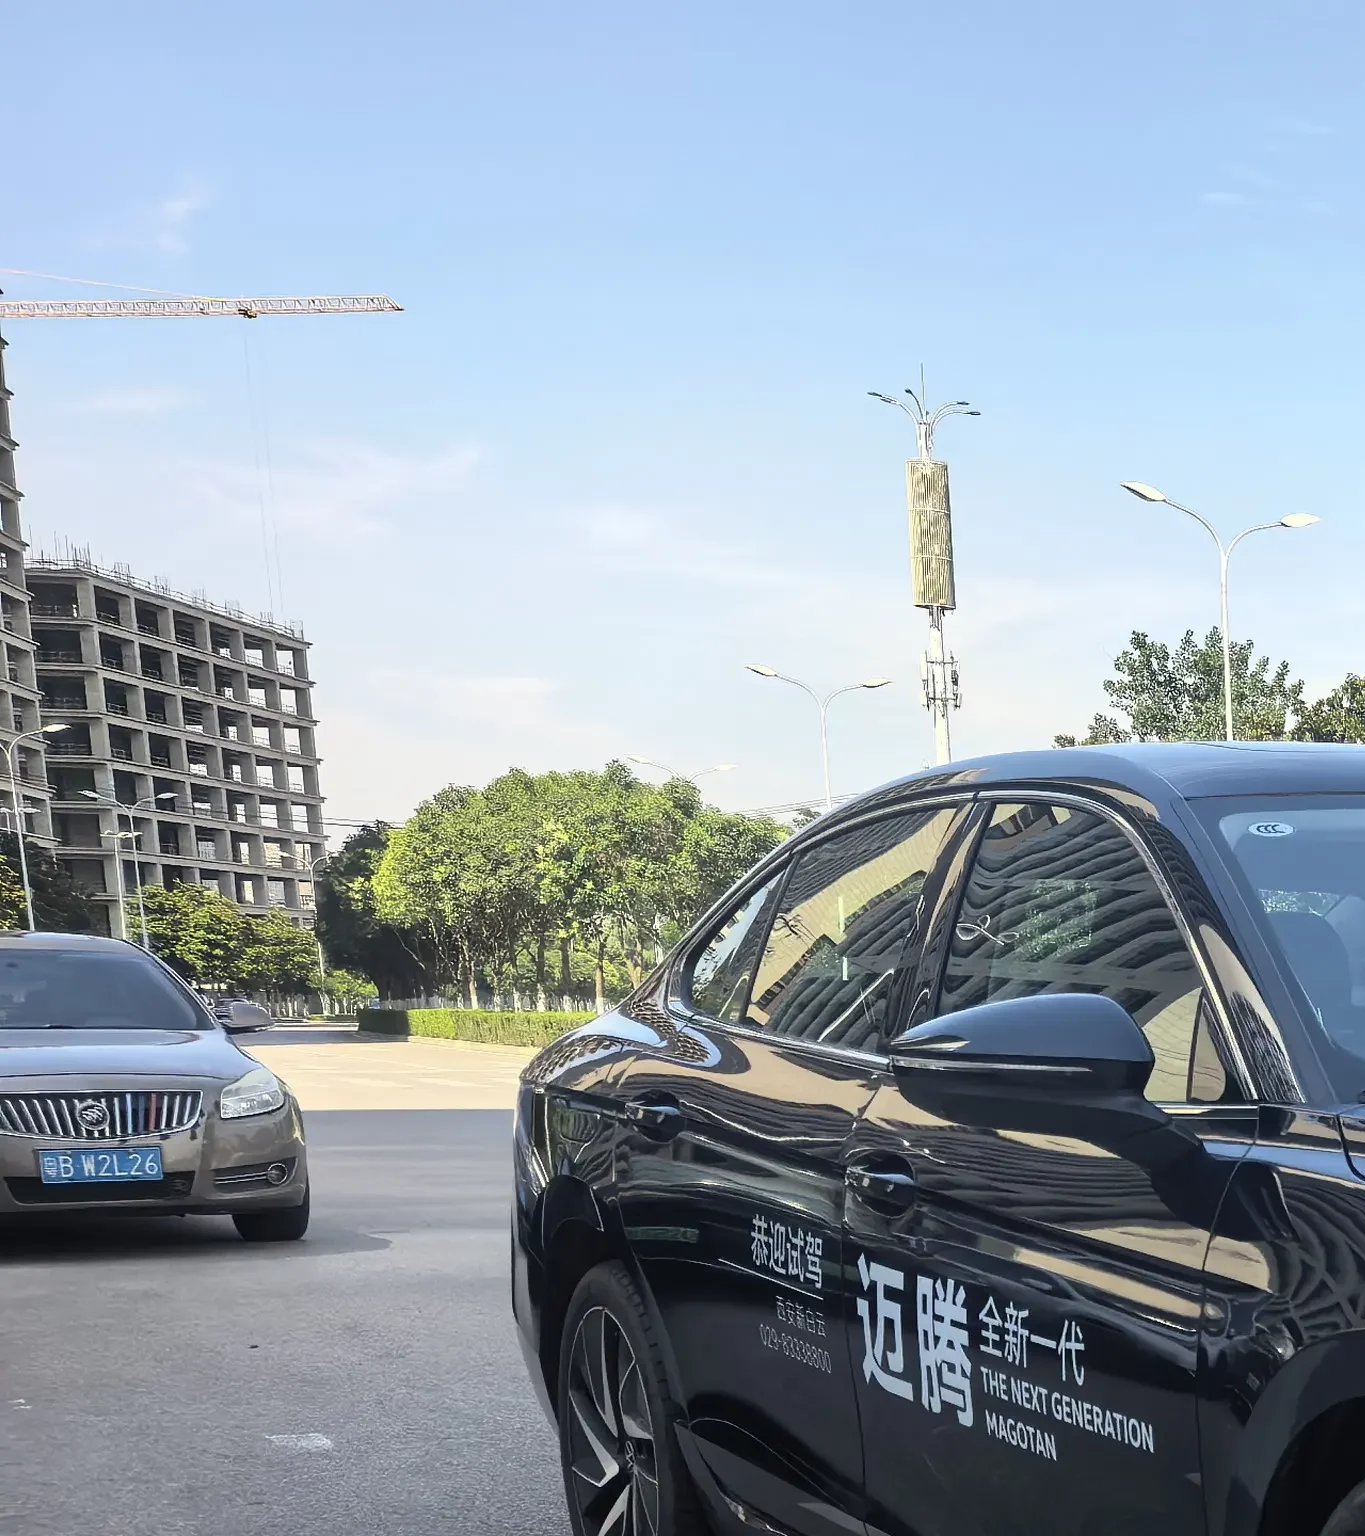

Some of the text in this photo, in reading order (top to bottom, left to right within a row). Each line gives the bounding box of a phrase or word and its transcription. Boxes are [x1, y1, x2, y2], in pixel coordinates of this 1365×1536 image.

[751, 1213, 823, 1290] 恭迎试驾
[776, 1295, 826, 1338] 西安新白云
[856, 1252, 974, 1428] 迈腾
[979, 1295, 1085, 1386] 全新一代
[980, 1366, 1154, 1453] THE NEXT GENERATION
[985, 1409, 1057, 1461] MAGOTAN
